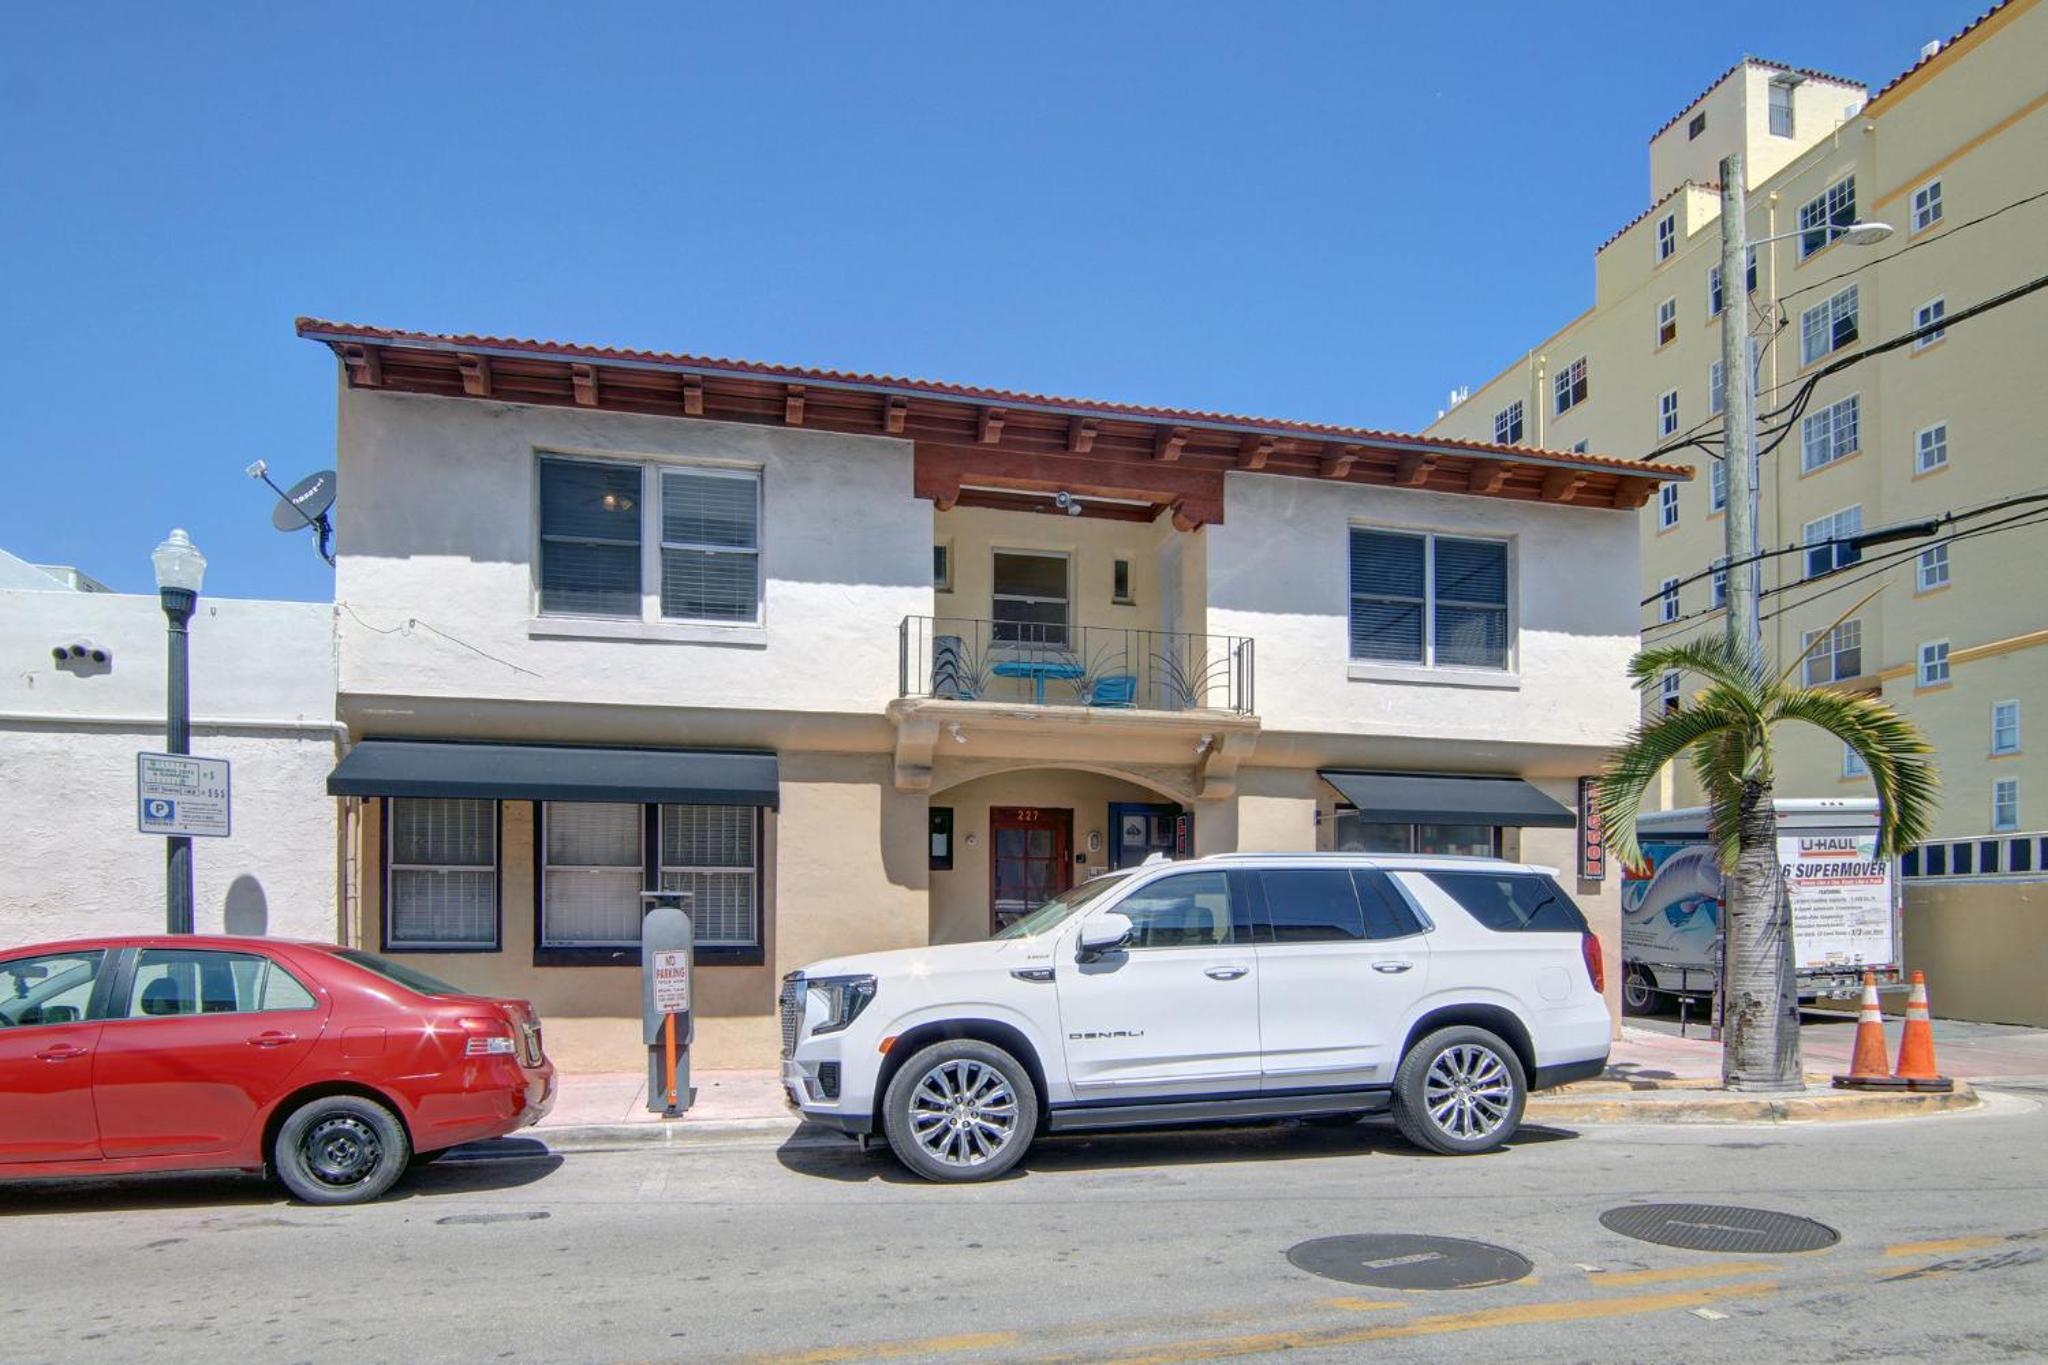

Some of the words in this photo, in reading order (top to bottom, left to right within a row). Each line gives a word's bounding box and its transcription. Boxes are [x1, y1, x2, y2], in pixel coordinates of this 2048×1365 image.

[155, 803, 164, 814] P
[1017, 809, 1039, 821] 227
[1795, 861, 1887, 878] SUPERMOVER
[664, 955, 676, 966] NO
[656, 967, 685, 979] PARKING
[1069, 1030, 1144, 1040] DENALI
